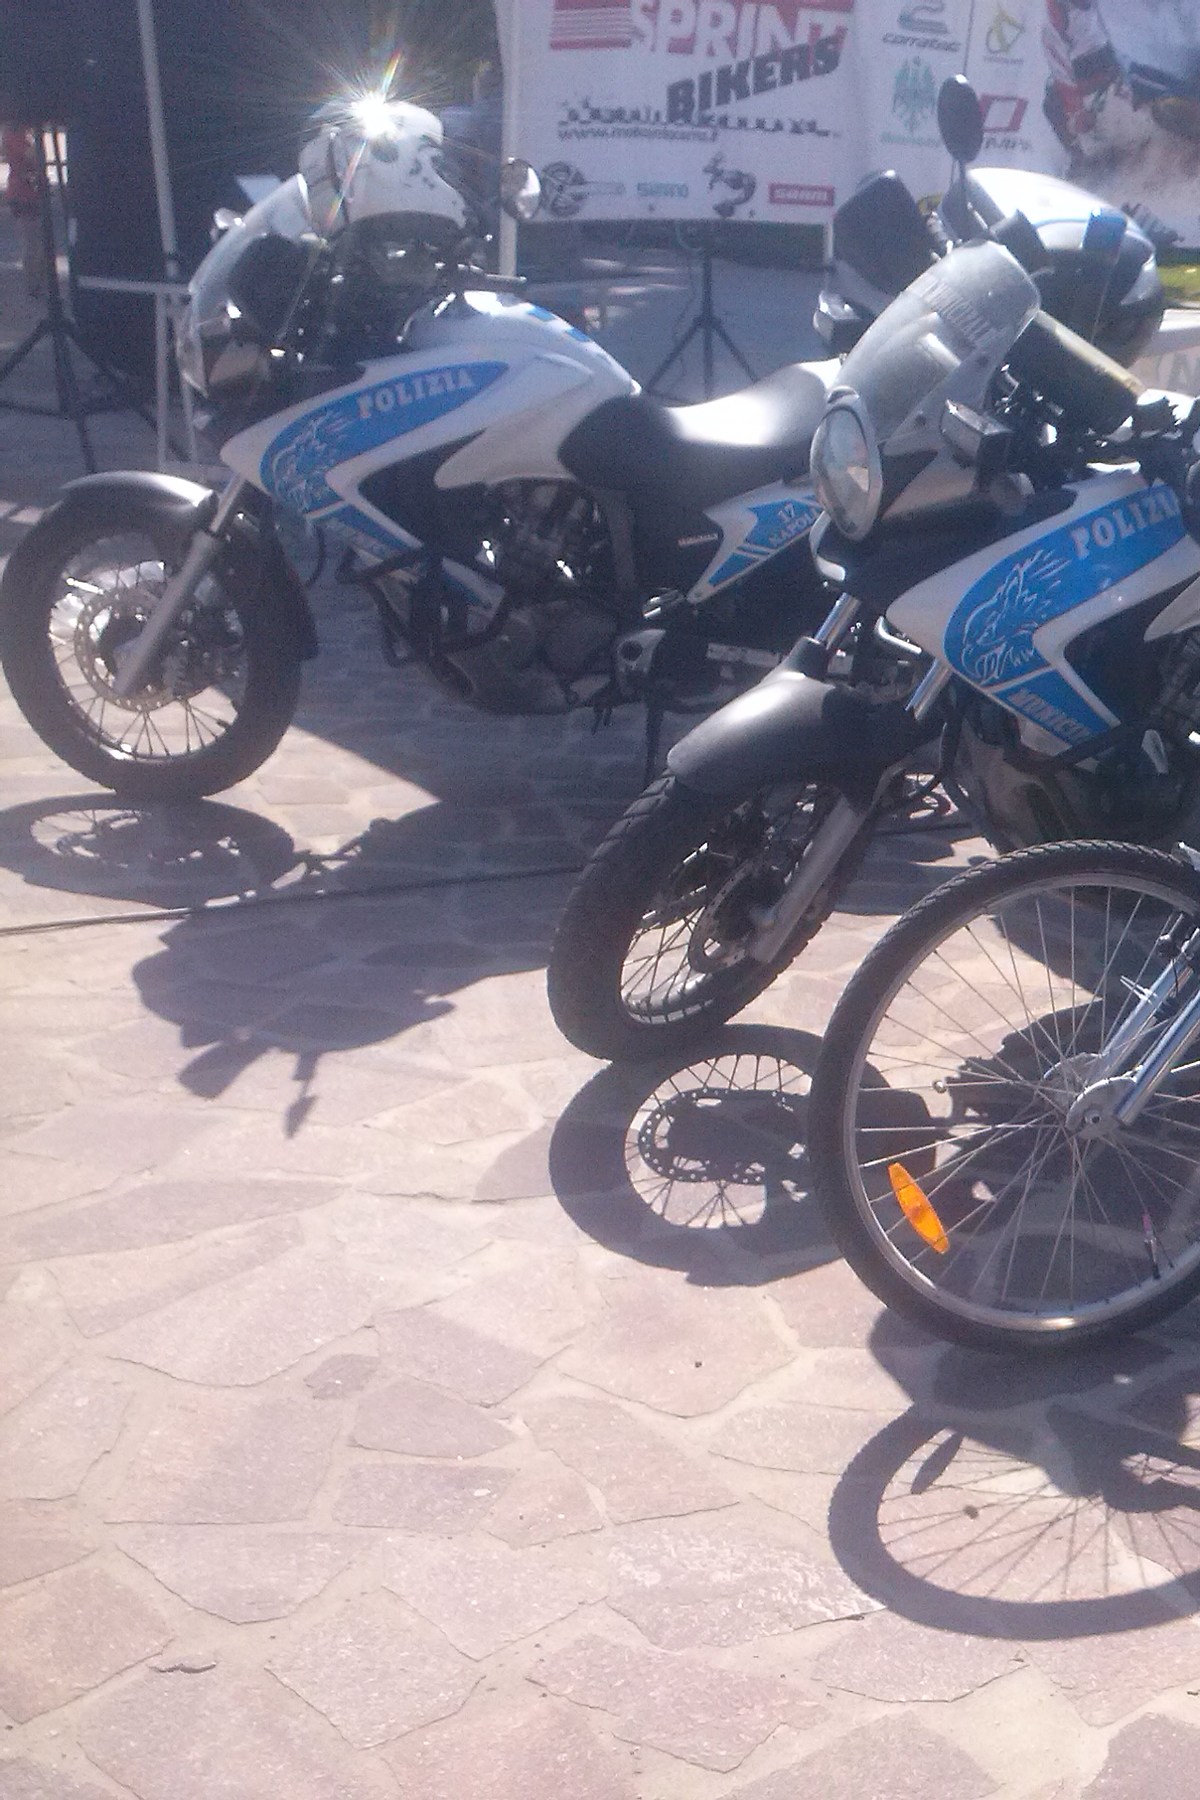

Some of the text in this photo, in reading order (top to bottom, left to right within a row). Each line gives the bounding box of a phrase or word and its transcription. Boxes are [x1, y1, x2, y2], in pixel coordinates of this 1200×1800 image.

[629, 0, 851, 60] SPRINT
[666, 35, 843, 124] BIKERS
[356, 367, 475, 419] POLIZIA
